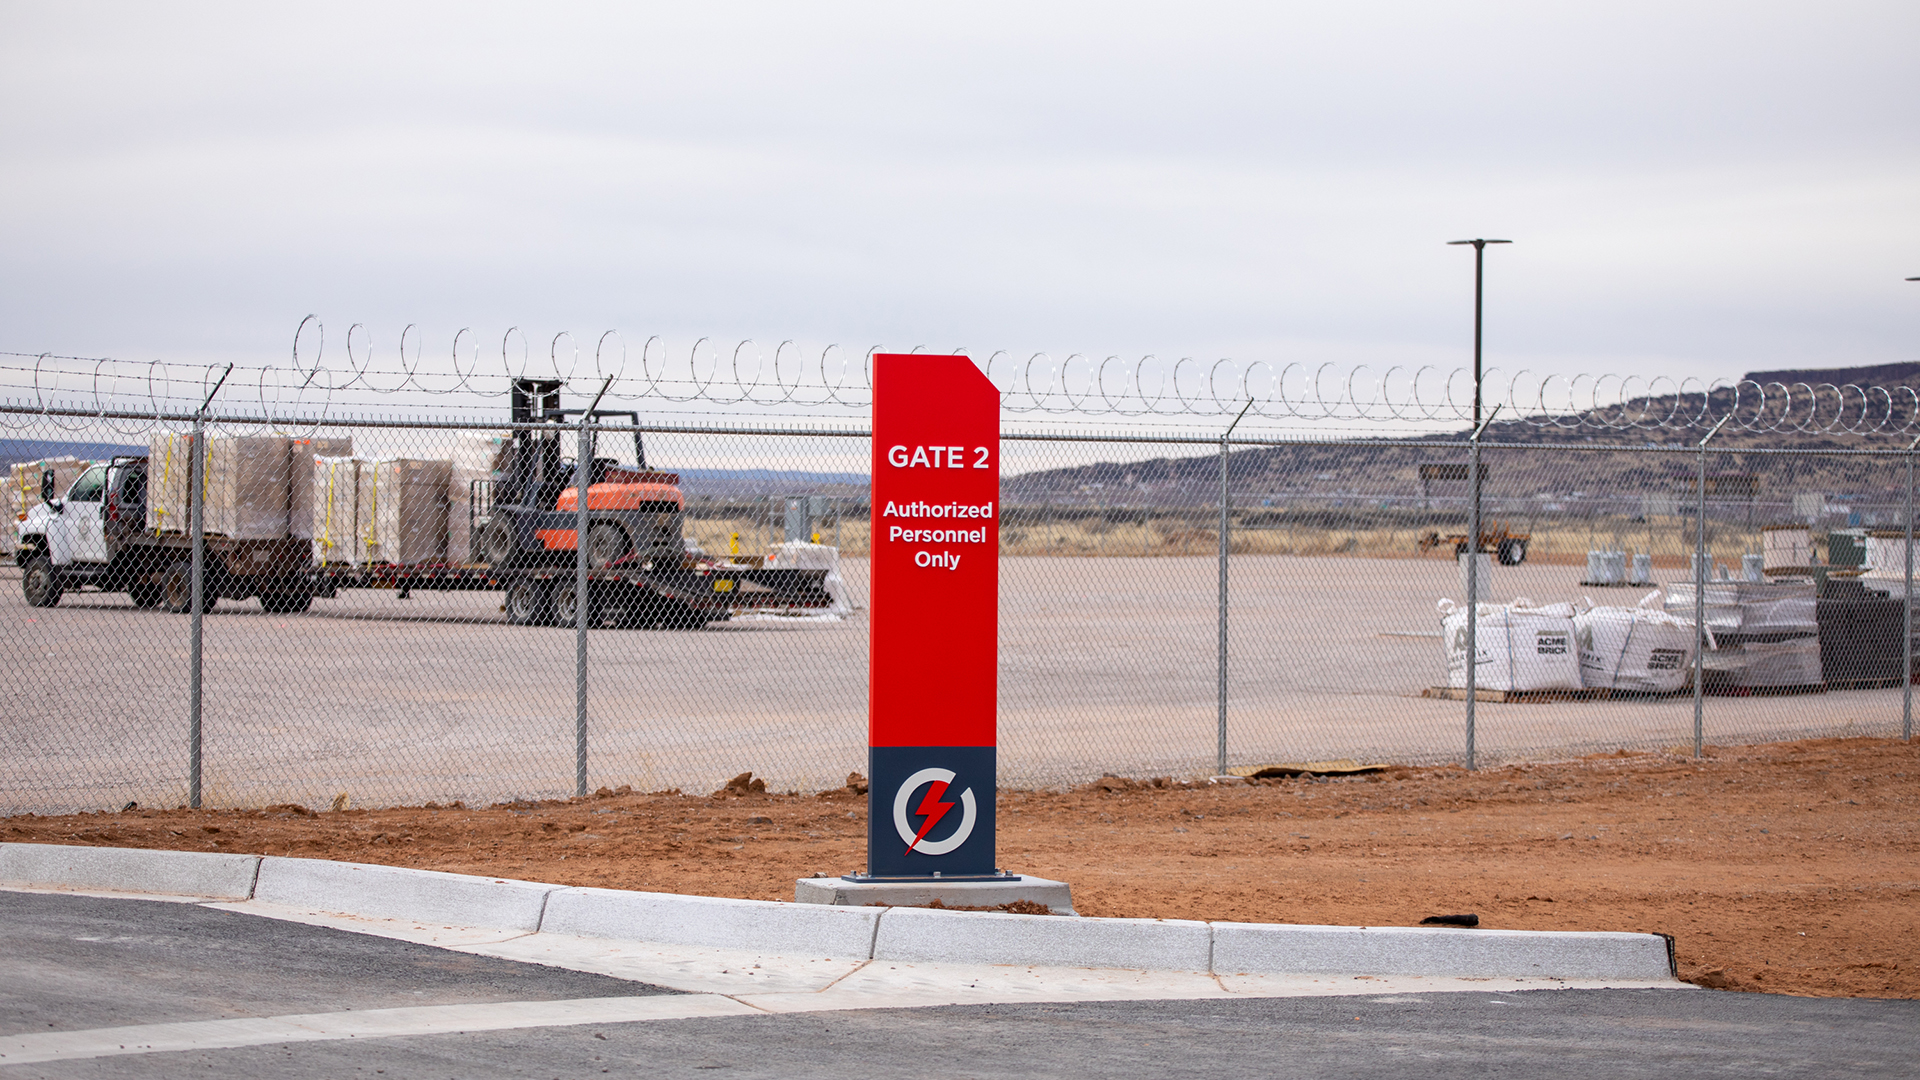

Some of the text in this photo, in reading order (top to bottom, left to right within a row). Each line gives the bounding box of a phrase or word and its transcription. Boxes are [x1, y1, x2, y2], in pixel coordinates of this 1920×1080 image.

[888, 445, 989, 469] GATE 2
[883, 500, 993, 518] Authorized
[889, 526, 986, 543] Personnel
[915, 551, 961, 571] Only
[1537, 637, 1567, 646] ACME
[1537, 646, 1568, 655] BRICK
[1649, 654, 1681, 663] ACME
[1646, 662, 1679, 670] BRICK
